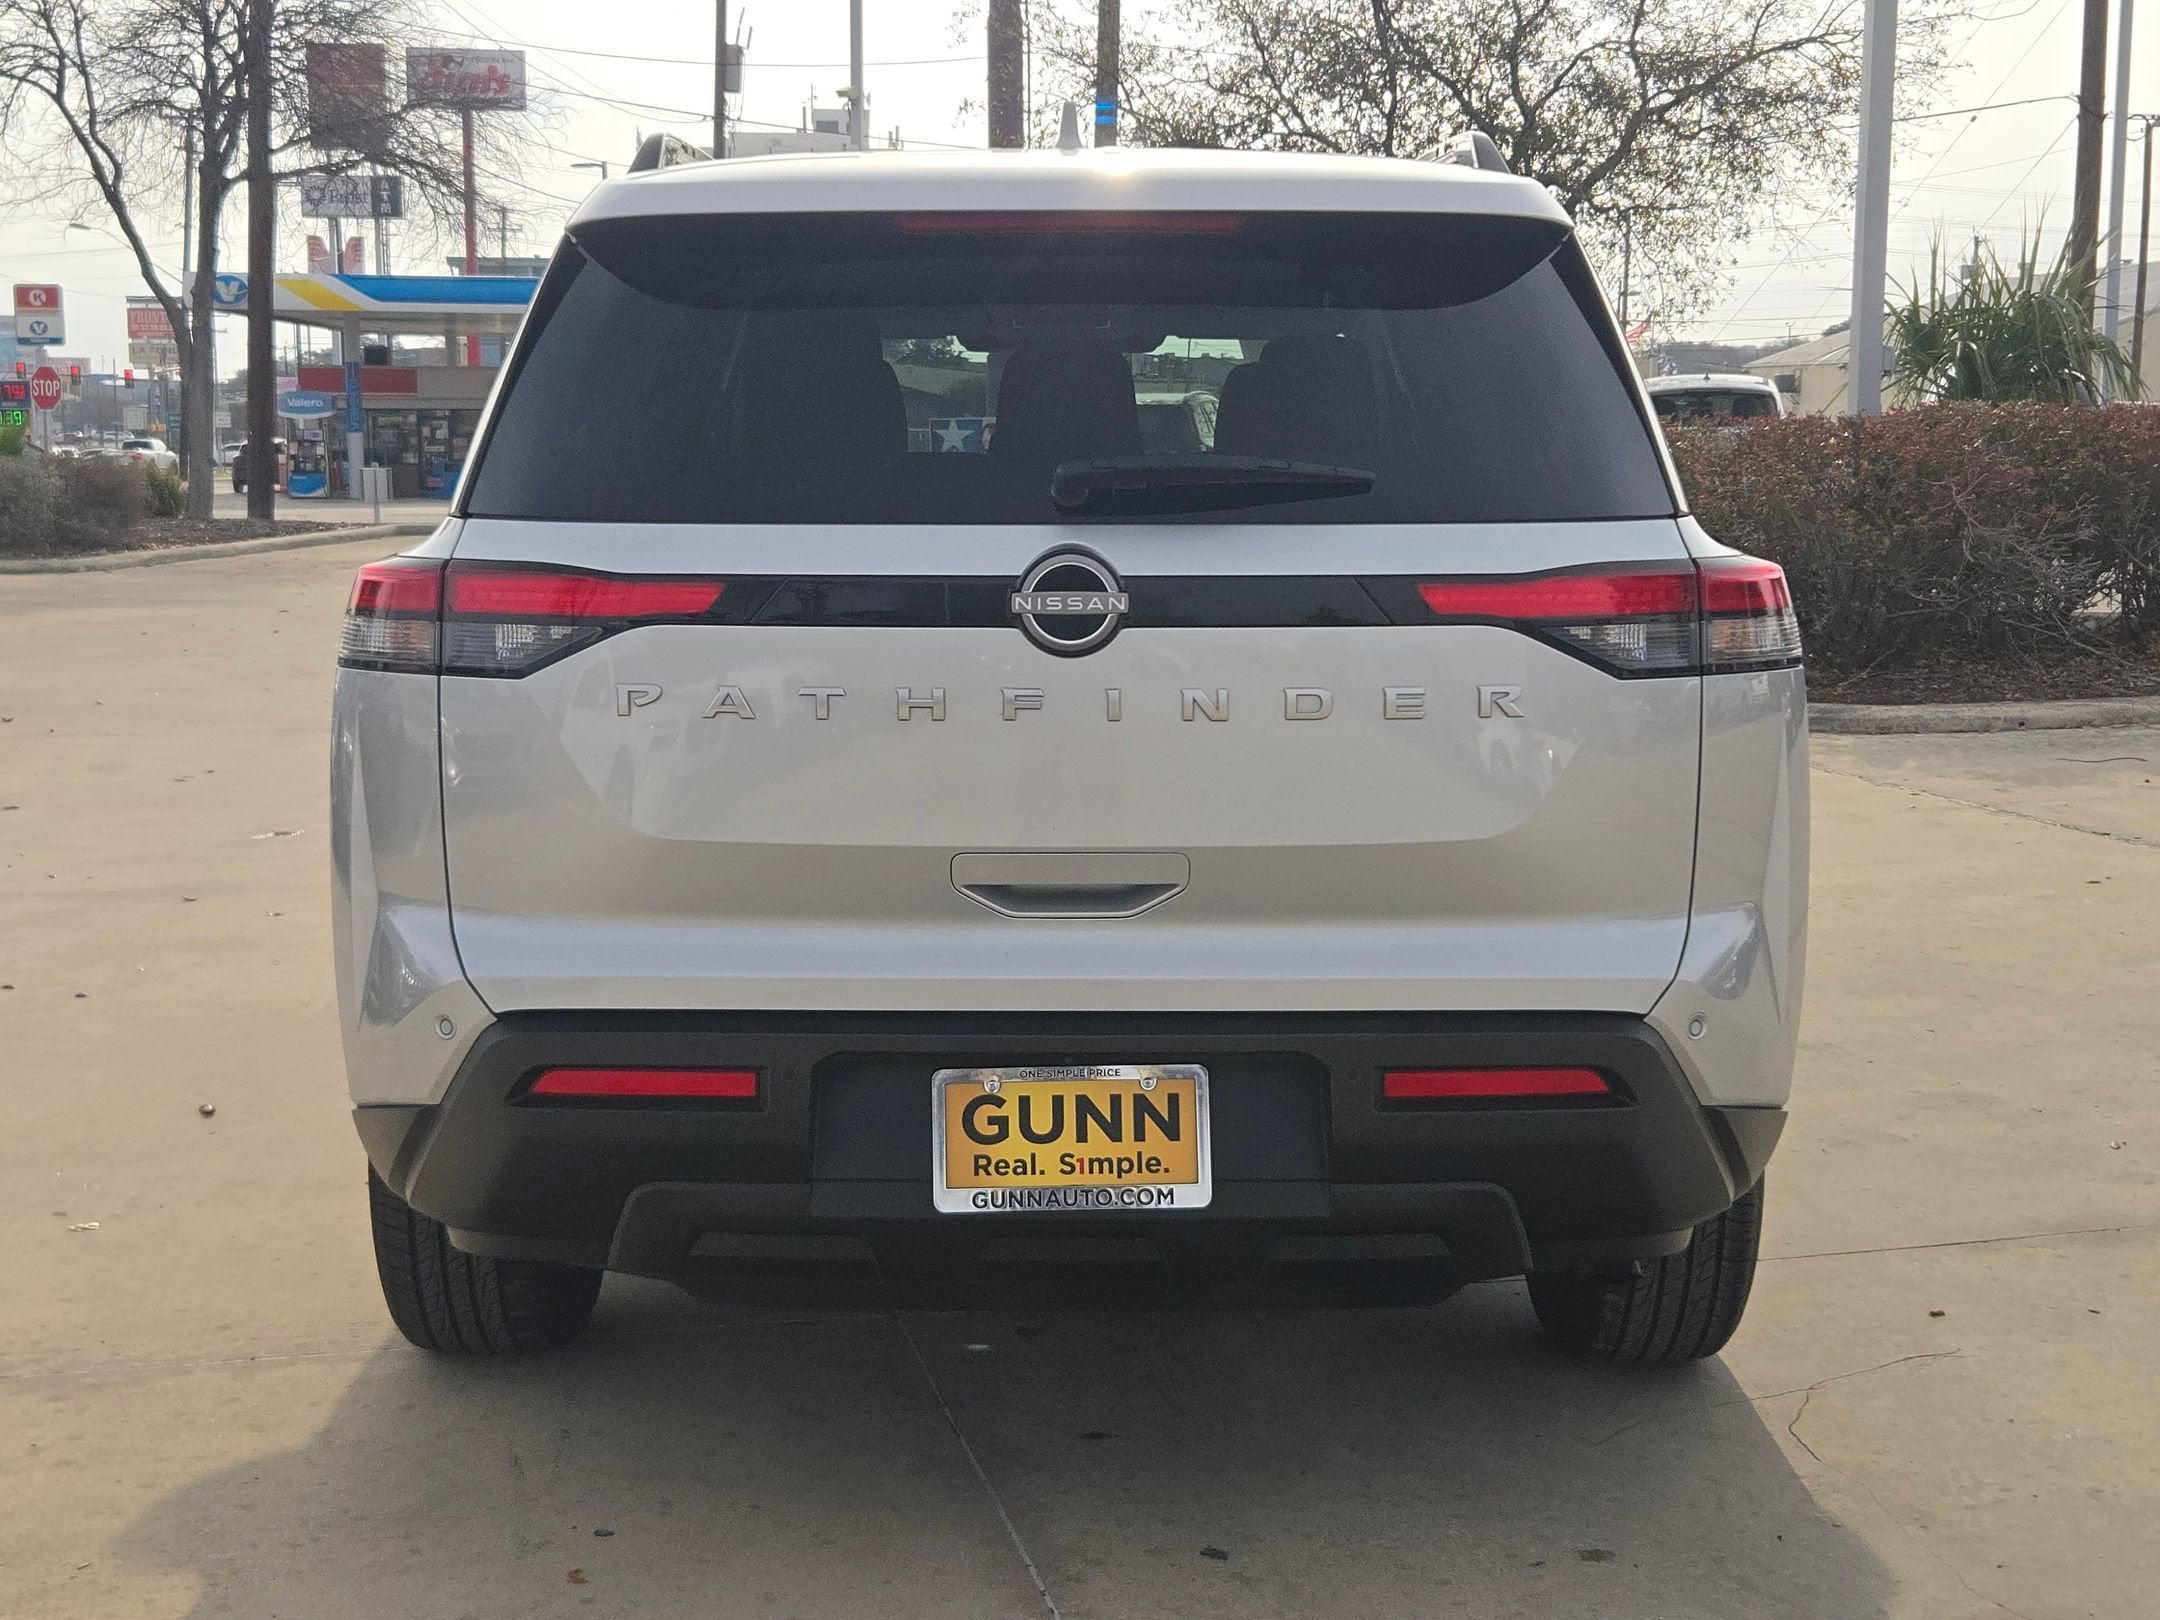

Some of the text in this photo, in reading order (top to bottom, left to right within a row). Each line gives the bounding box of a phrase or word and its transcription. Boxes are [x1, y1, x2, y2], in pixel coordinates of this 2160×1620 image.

[380, 181, 392, 214] ATM
[130, 310, 168, 324] FRONT
[33, 380, 60, 397] STOP
[287, 398, 324, 407] Valero
[1015, 597, 1126, 610] NISSAN
[616, 683, 1524, 721] PATHFINDER
[1019, 1068, 1121, 1078] ONE SIMPLE PRICE
[962, 1093, 1181, 1146] GUNN
[973, 1153, 1046, 1177] Real.
[972, 1187, 1175, 1209] GUNNAUTO.COM
